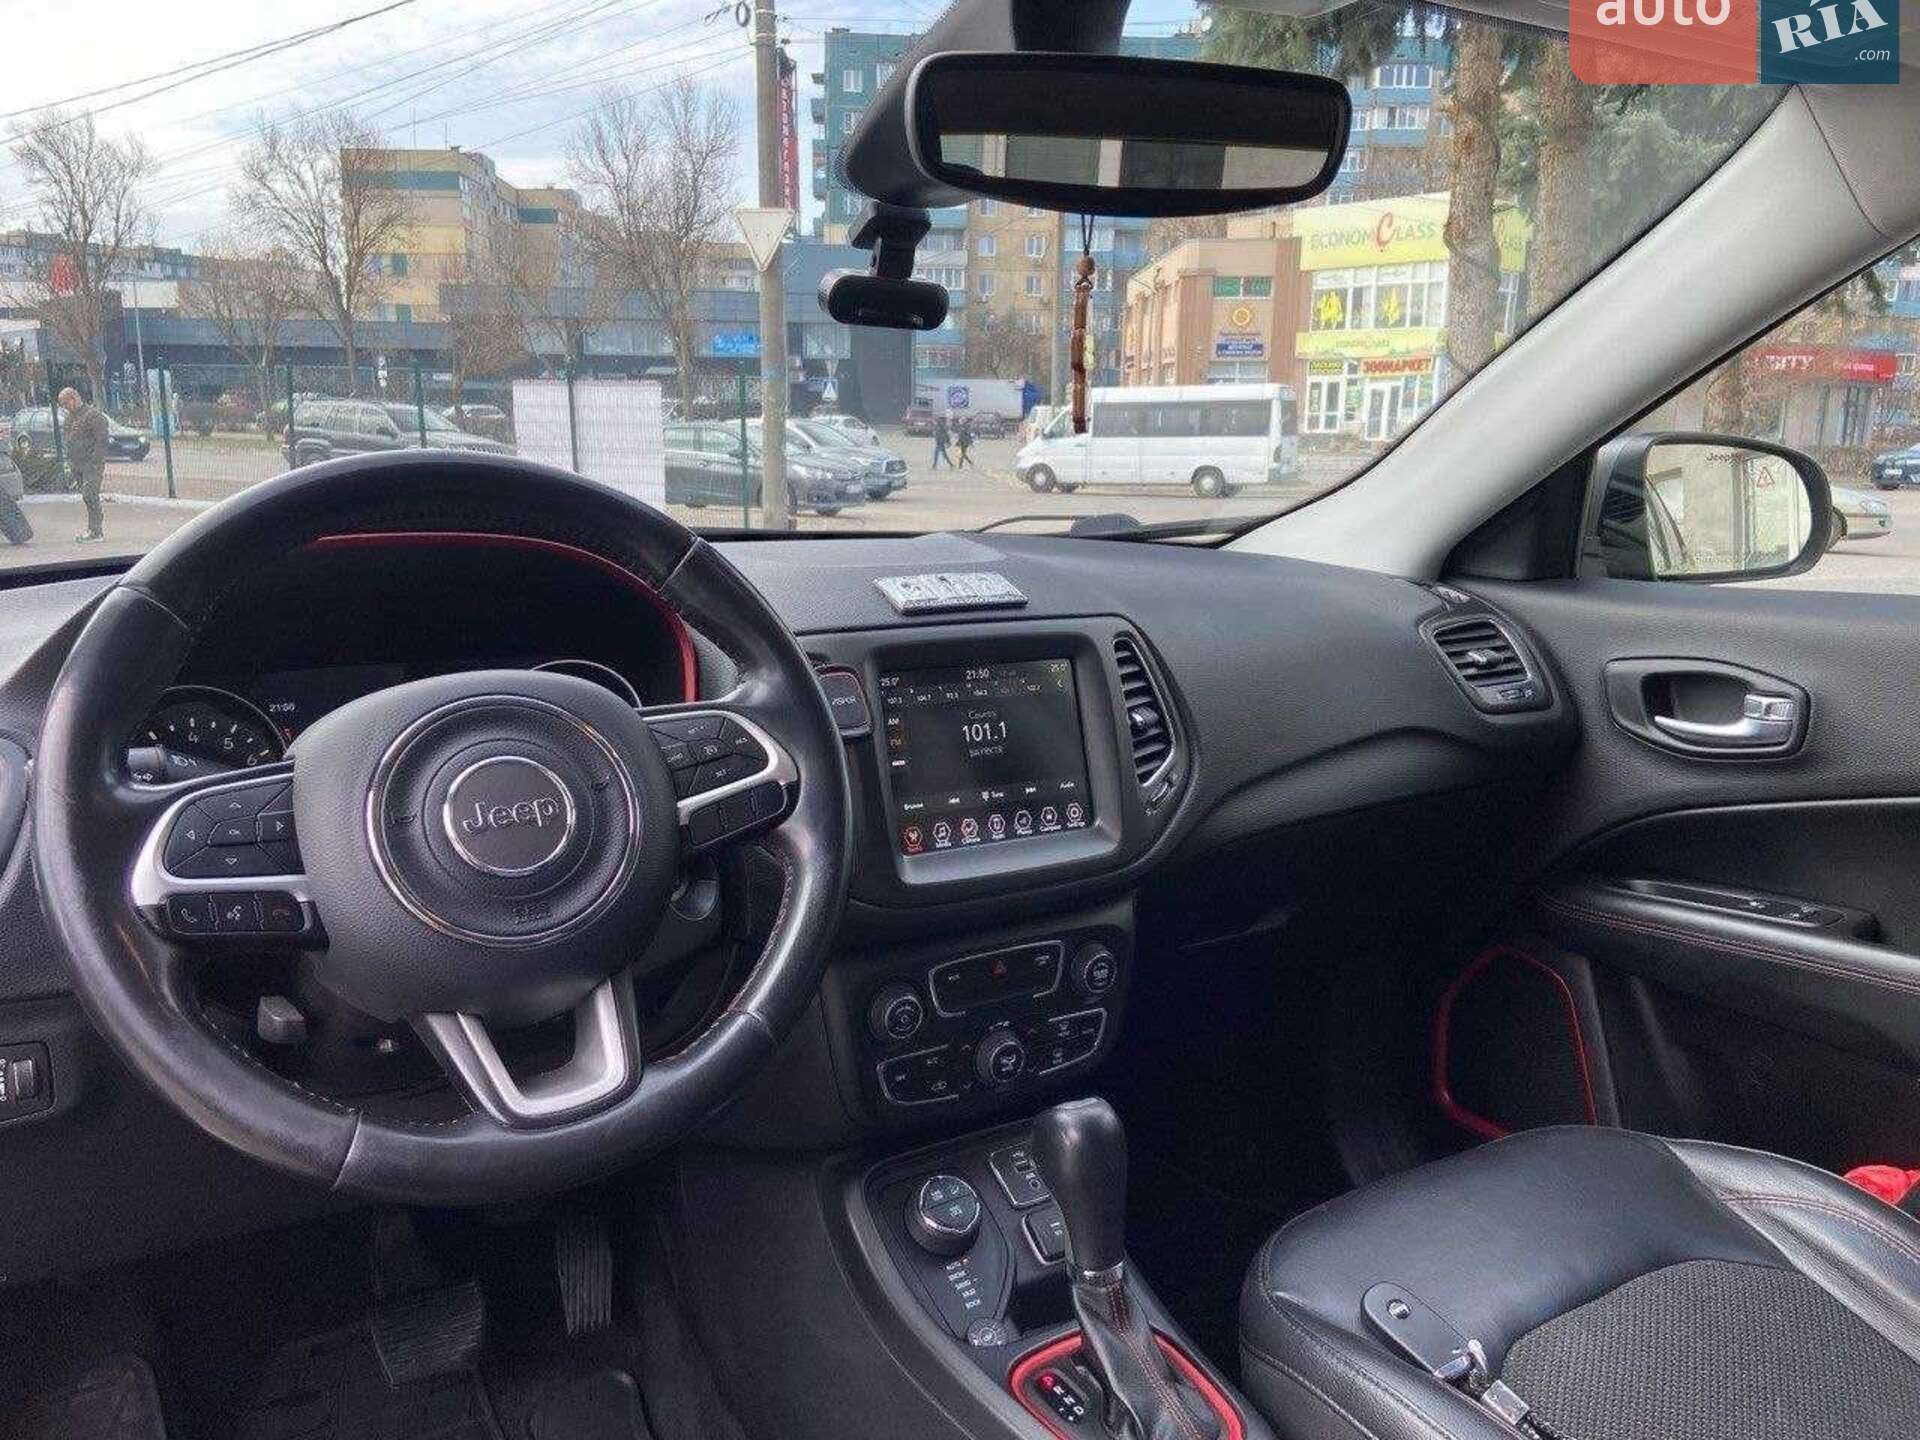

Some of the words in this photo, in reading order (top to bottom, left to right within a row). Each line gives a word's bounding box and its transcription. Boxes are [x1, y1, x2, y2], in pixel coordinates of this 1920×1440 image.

[189, 732, 199, 743] 4
[962, 720, 1007, 742] 101.1
[223, 737, 234, 750] 5
[247, 754, 258, 766] 6
[462, 797, 560, 835] Jeep
